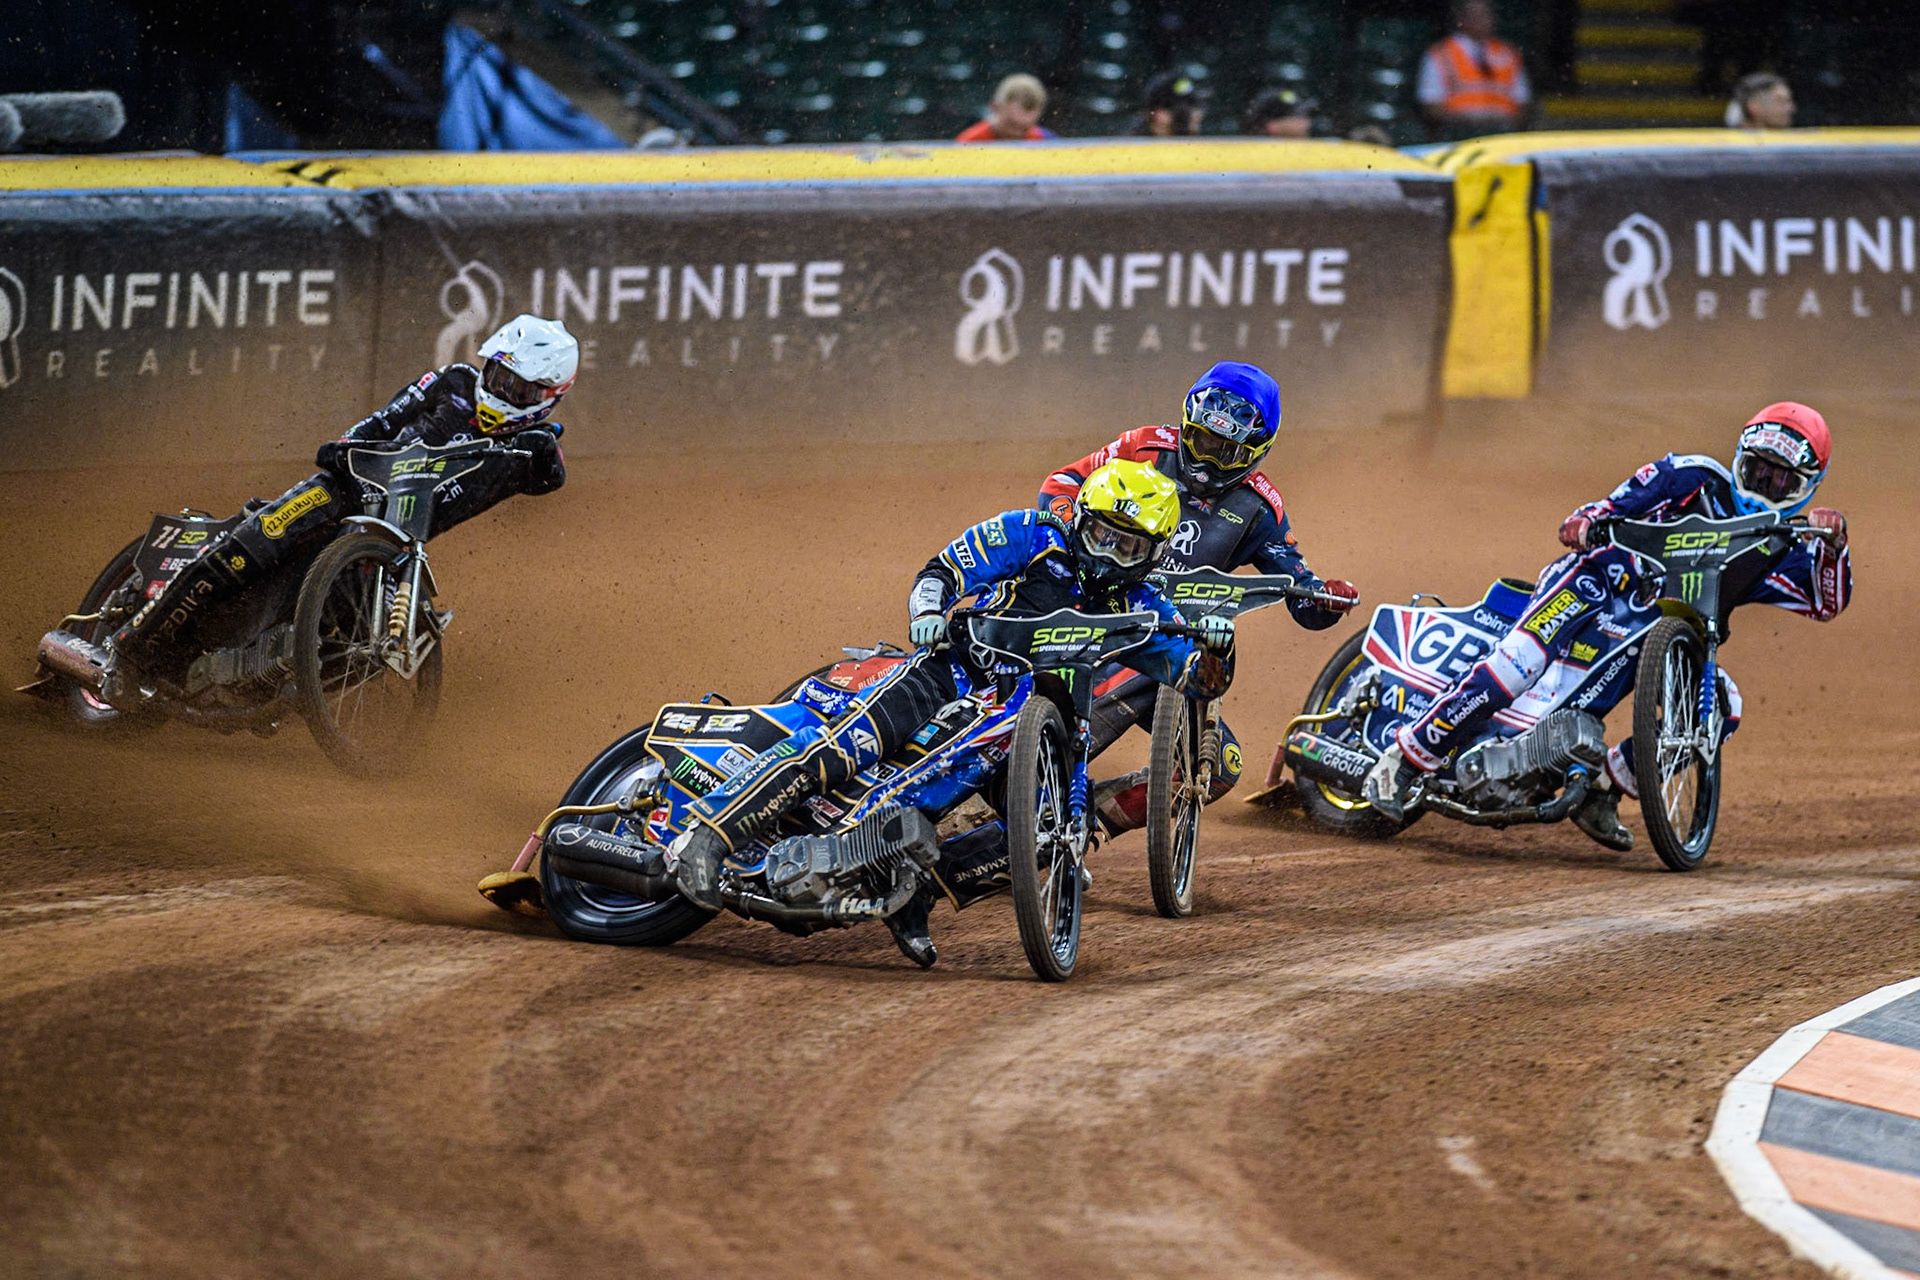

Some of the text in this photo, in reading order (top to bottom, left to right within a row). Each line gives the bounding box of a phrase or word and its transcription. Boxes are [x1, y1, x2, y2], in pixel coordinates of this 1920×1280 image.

[531, 261, 845, 323] INFINITE
[1046, 248, 1350, 311] INFINITE
[51, 269, 336, 332] INFINITE
[578, 333, 840, 370] EALITY
[1043, 321, 1344, 355] REALITY
[46, 343, 328, 379] REALITY
[265, 489, 327, 534] 123drukuj.pl
[1217, 508, 1245, 525] SGP
[1530, 592, 1576, 630] POWER
[1539, 599, 1583, 640] MAXED
[1039, 644, 1067, 652] SPEEDWAY
[1410, 622, 1490, 680] GB
[1449, 689, 1490, 727] Mobility
[1322, 753, 1365, 777] GROUP
[757, 772, 809, 820] MONSTE
[586, 838, 644, 859] AUTO-FRELIK
